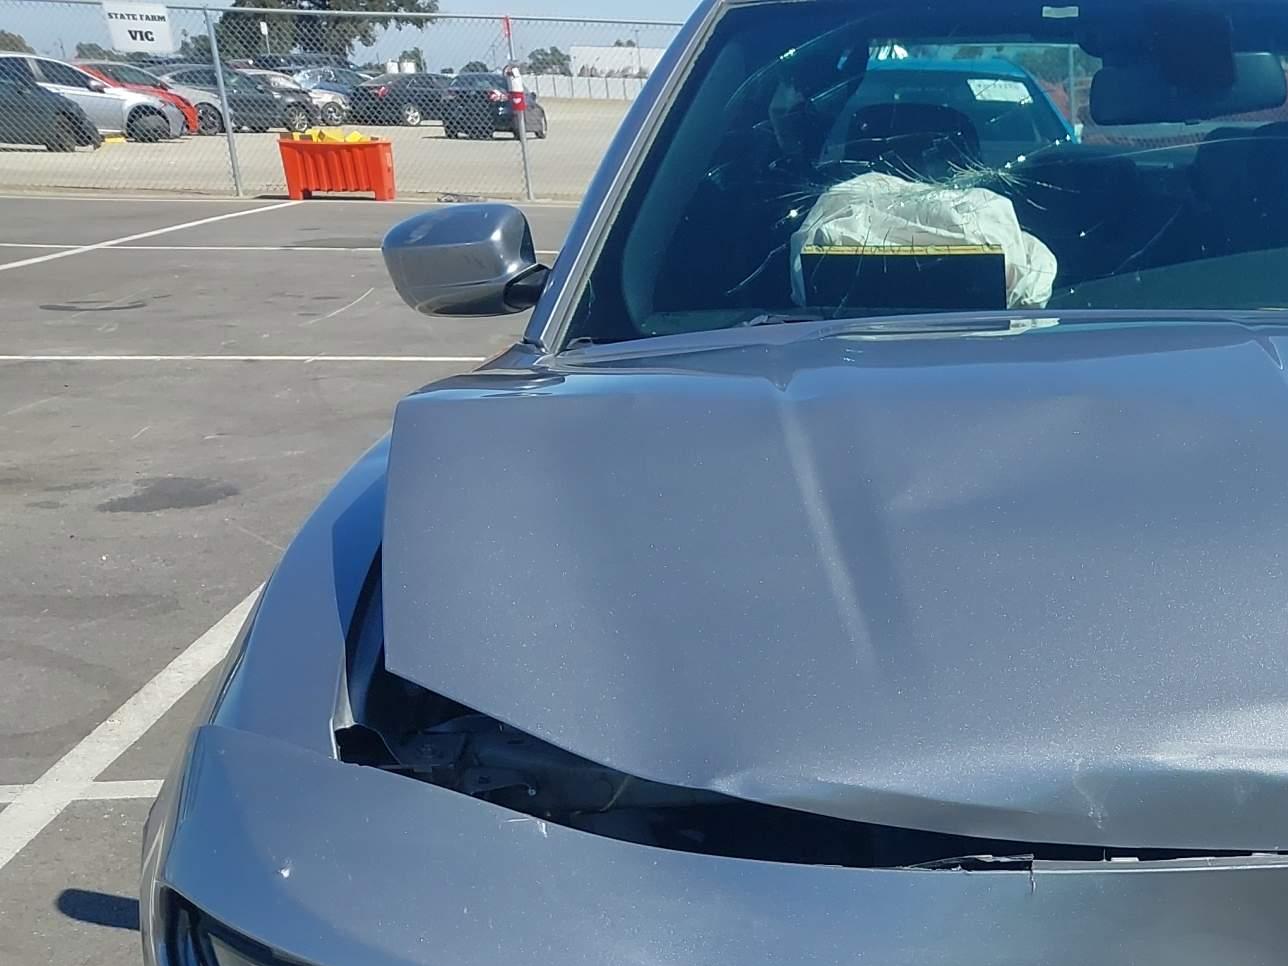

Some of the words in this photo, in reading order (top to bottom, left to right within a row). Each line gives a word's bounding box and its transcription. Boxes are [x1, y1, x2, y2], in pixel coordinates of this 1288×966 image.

[107, 12, 138, 21] STATE
[139, 14, 167, 22] FARM
[127, 30, 155, 42] VIC
